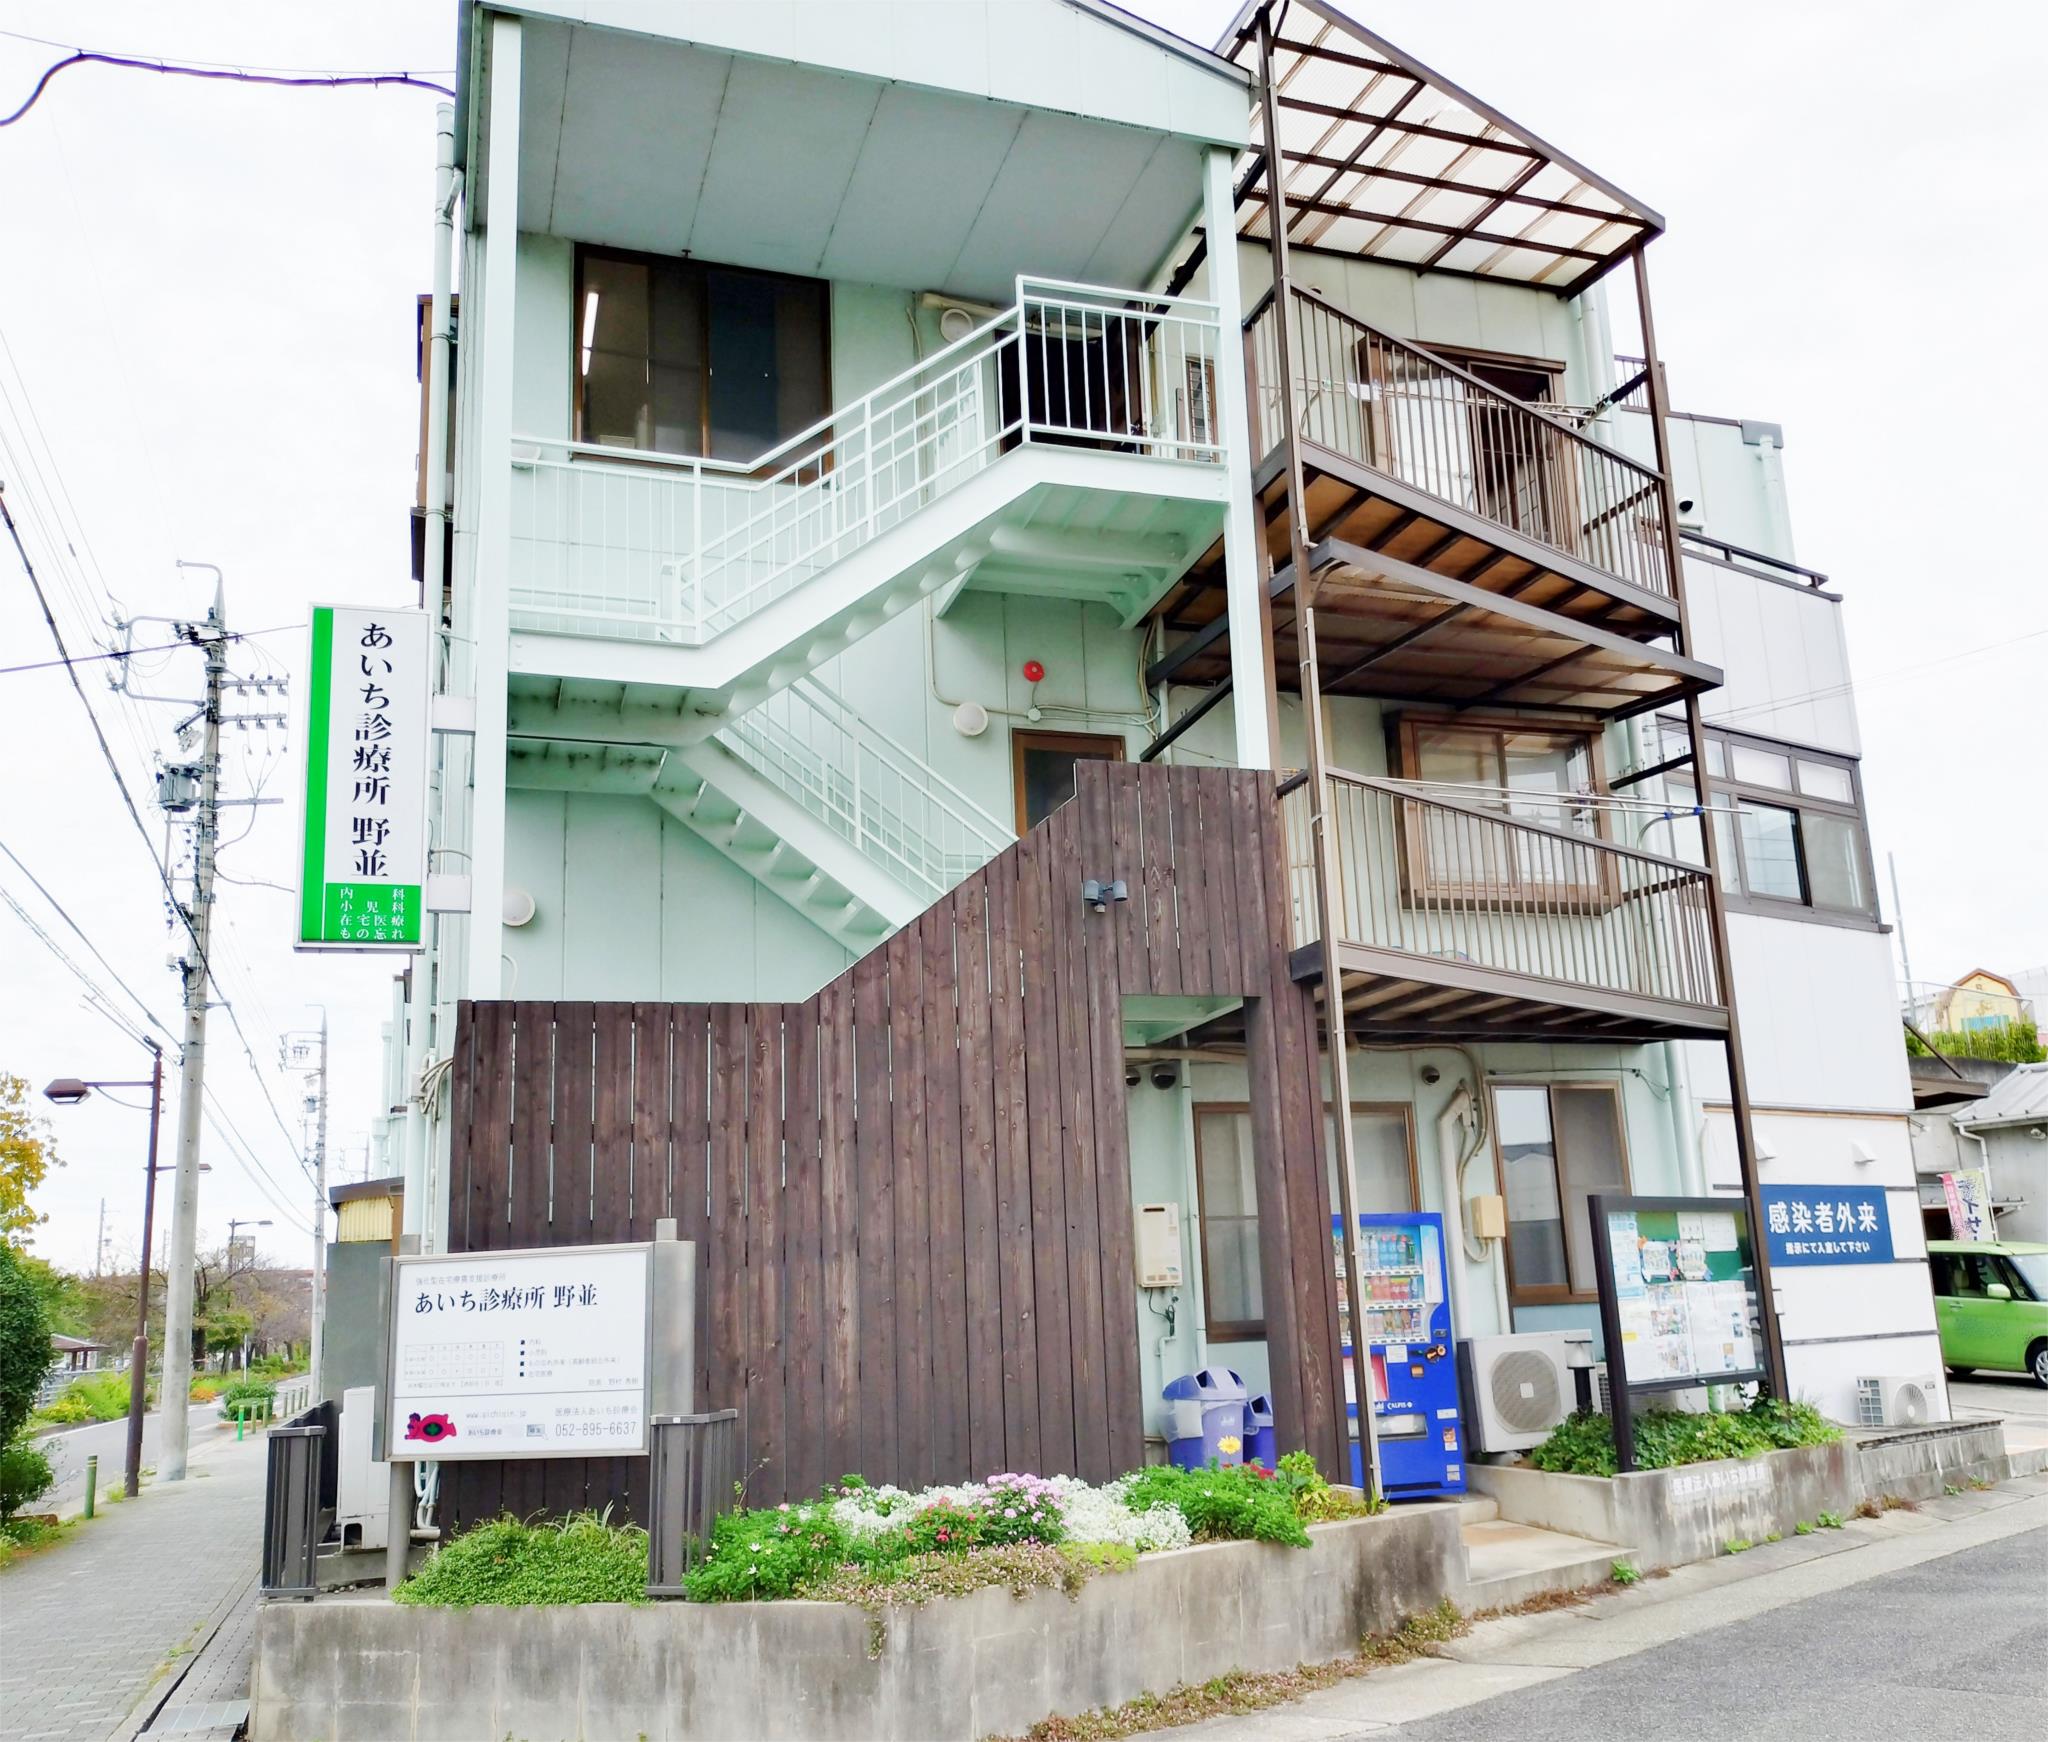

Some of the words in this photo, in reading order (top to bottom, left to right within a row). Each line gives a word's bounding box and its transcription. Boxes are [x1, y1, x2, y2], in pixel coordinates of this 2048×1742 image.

[352, 622, 393, 806] あいち診療所
[351, 816, 391, 877] 野並
[340, 914, 405, 926] 在宅医療
[340, 927, 405, 940] もの忘れ
[1768, 1201, 1879, 1234] 感染者外来
[415, 1286, 546, 1315] あいち診療所
[553, 1284, 598, 1309] 野並
[555, 1421, 637, 1437] 052-895-6637
